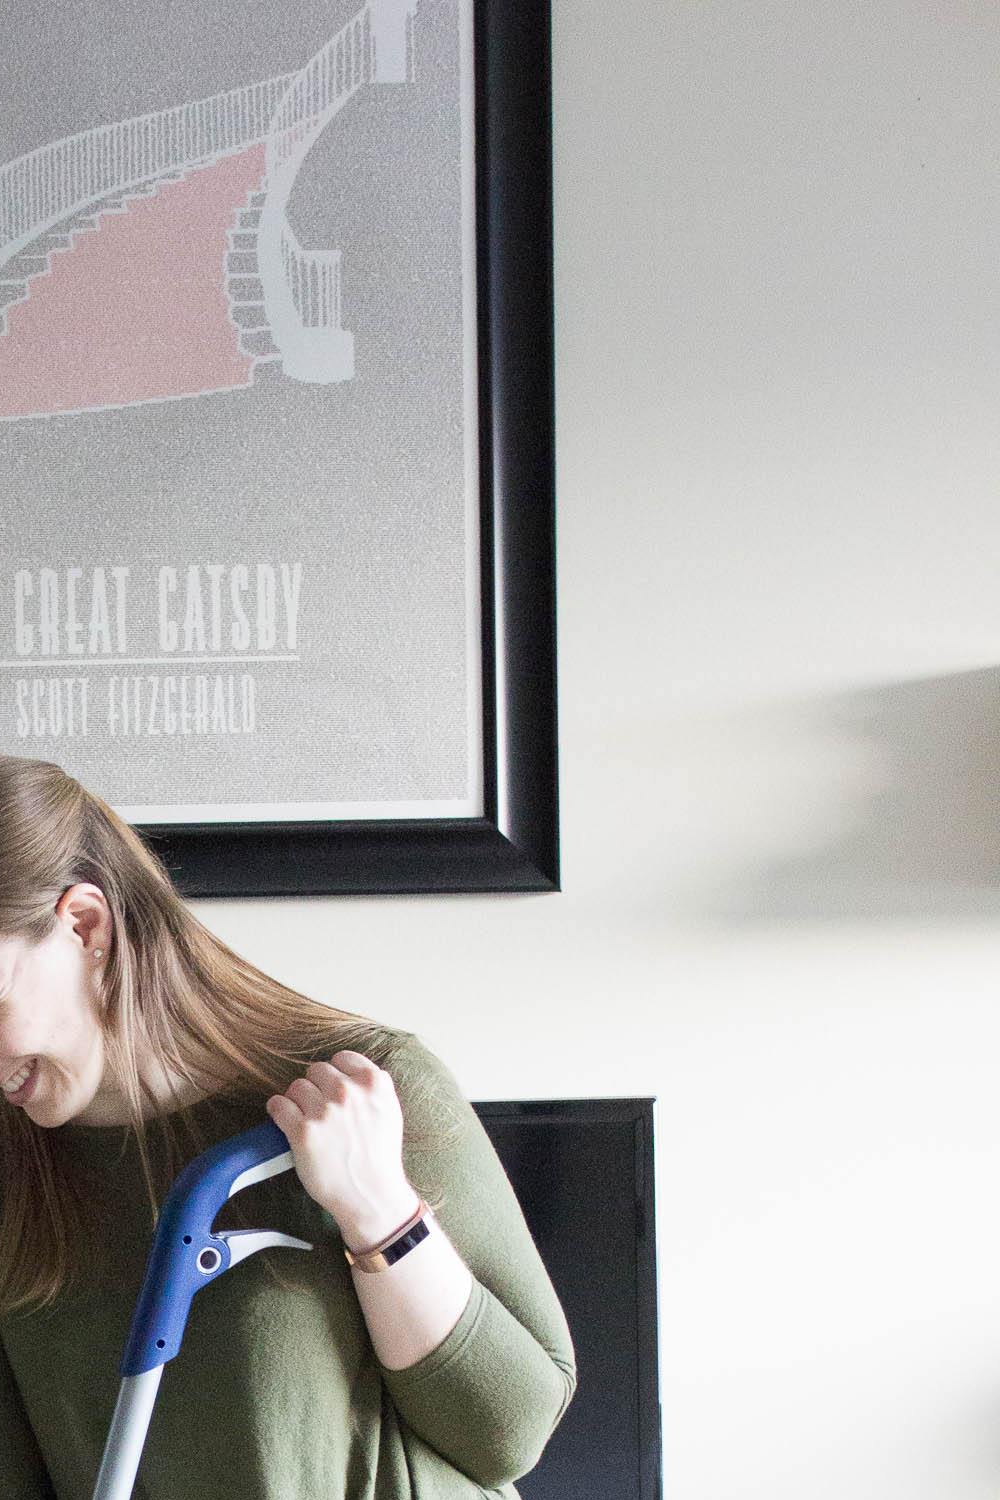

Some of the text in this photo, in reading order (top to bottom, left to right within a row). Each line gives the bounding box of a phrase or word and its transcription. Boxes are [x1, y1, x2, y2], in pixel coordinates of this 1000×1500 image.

[14, 567, 130, 656] GREAT
[158, 562, 301, 652] GATSBY
[15, 677, 89, 738] SCOTT
[108, 675, 257, 736] FITZGERALD
